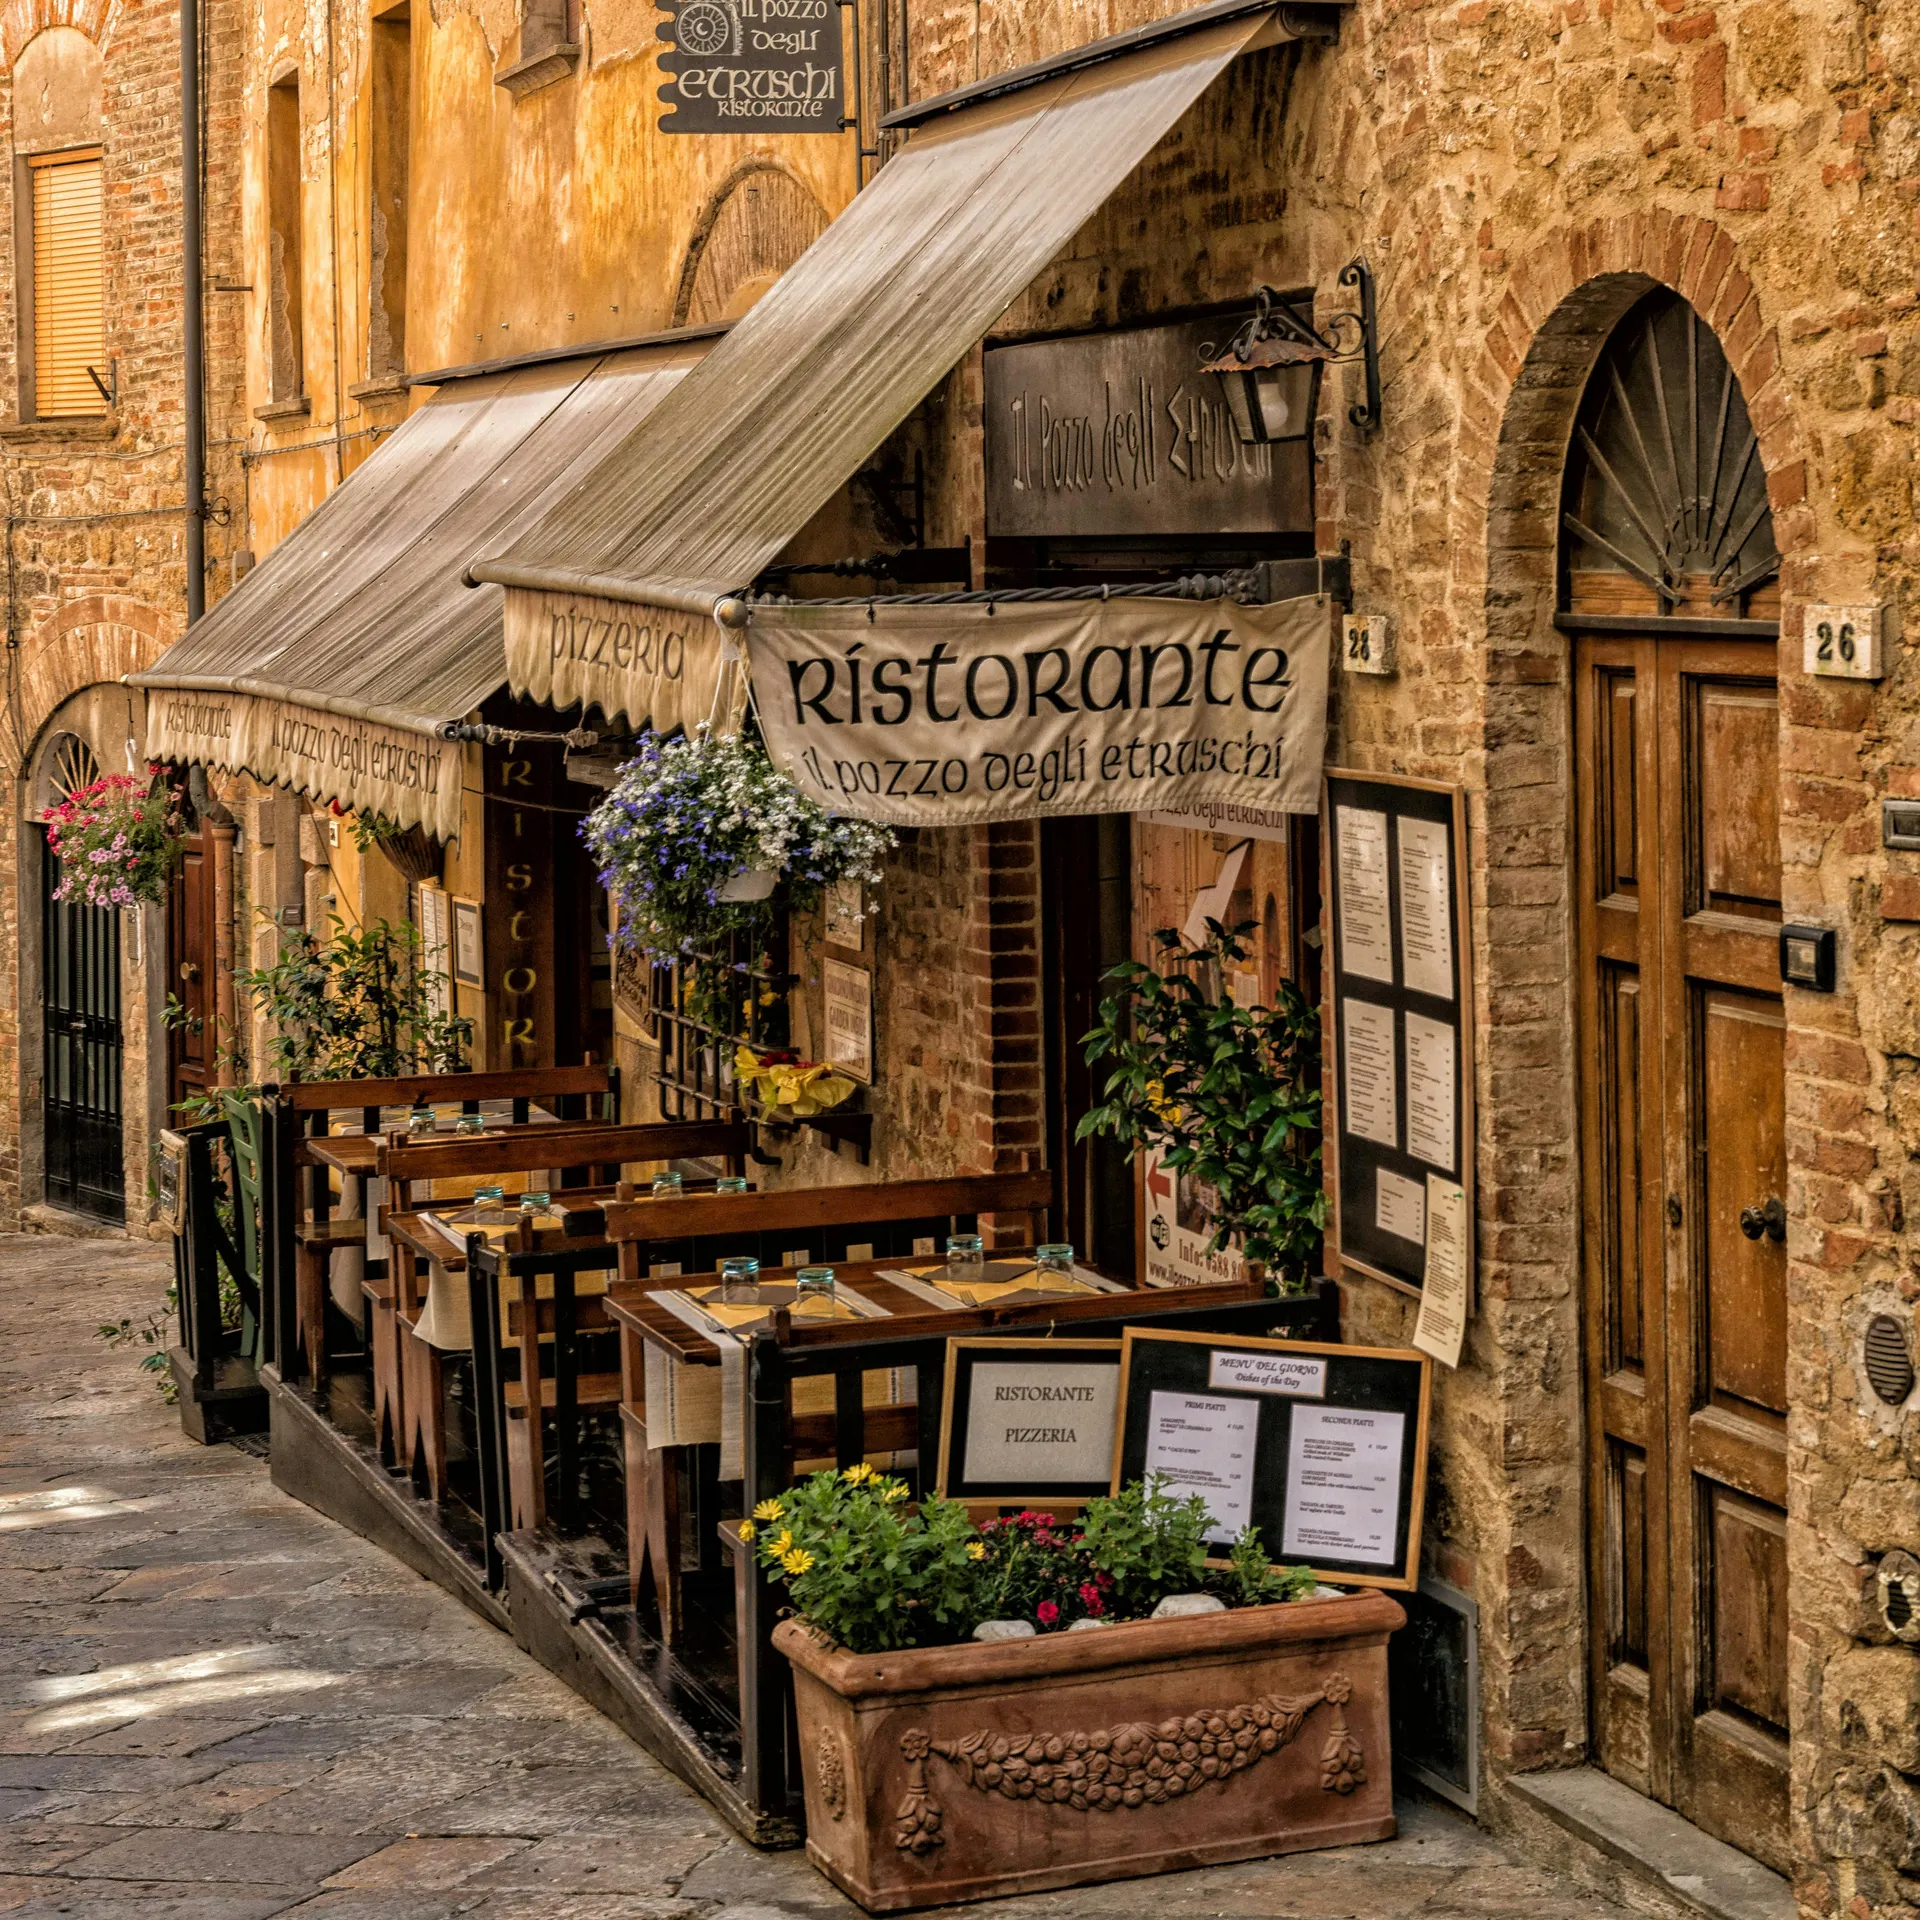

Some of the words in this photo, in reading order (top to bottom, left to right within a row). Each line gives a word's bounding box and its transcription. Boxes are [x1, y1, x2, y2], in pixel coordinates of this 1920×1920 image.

[1348, 627, 1370, 662] 28
[1816, 621, 1855, 662] 26
[1256, 1361, 1277, 1372] DEL
[1280, 1364, 1319, 1376] GIORNO
[1235, 1372, 1260, 1383] Dishes
[1260, 1375, 1270, 1386] of
[1270, 1376, 1282, 1384] the
[1284, 1377, 1300, 1388] Day
[994, 1386, 1094, 1401] RISTORANTE
[1004, 1428, 1077, 1444] PIZZERIA
